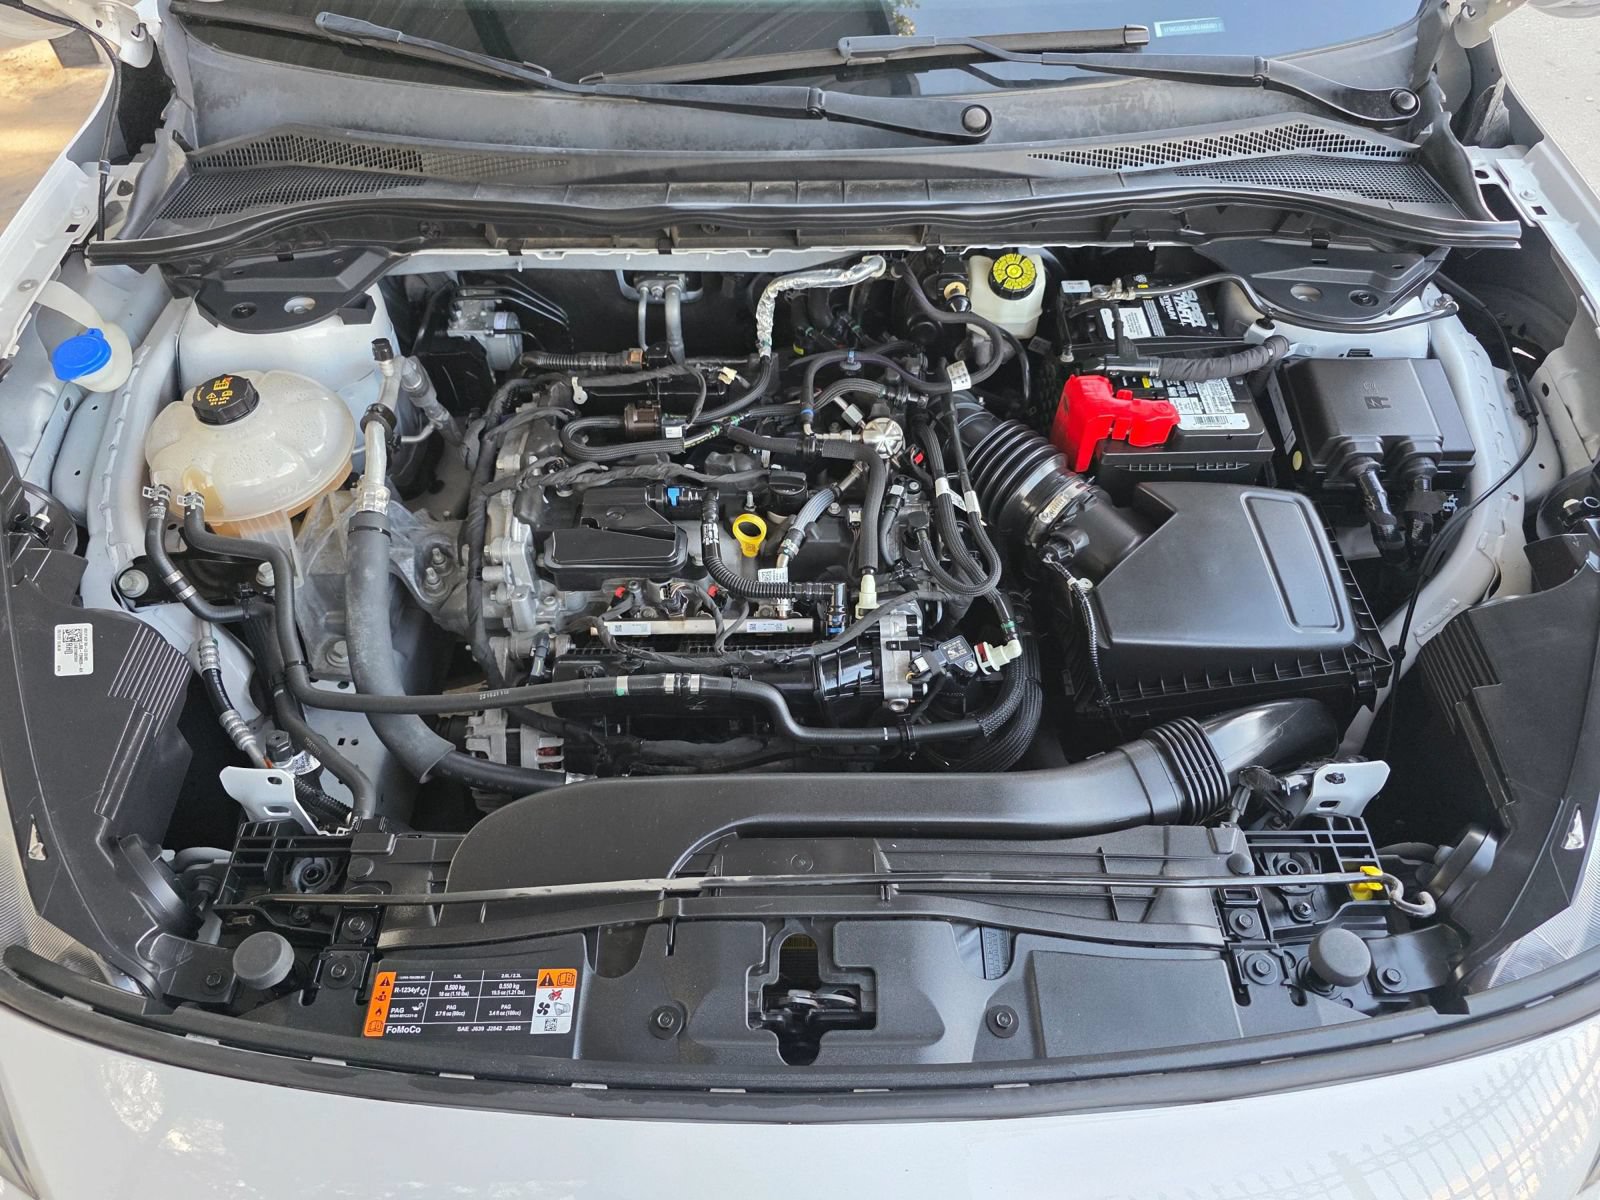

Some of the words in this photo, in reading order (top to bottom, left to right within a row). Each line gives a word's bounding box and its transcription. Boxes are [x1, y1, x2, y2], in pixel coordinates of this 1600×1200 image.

[1184, 289, 1207, 328] SUPER
[394, 986, 420, 995] R-1234yf
[513, 982, 520, 990] kg
[386, 1025, 421, 1034] FoMoCo
